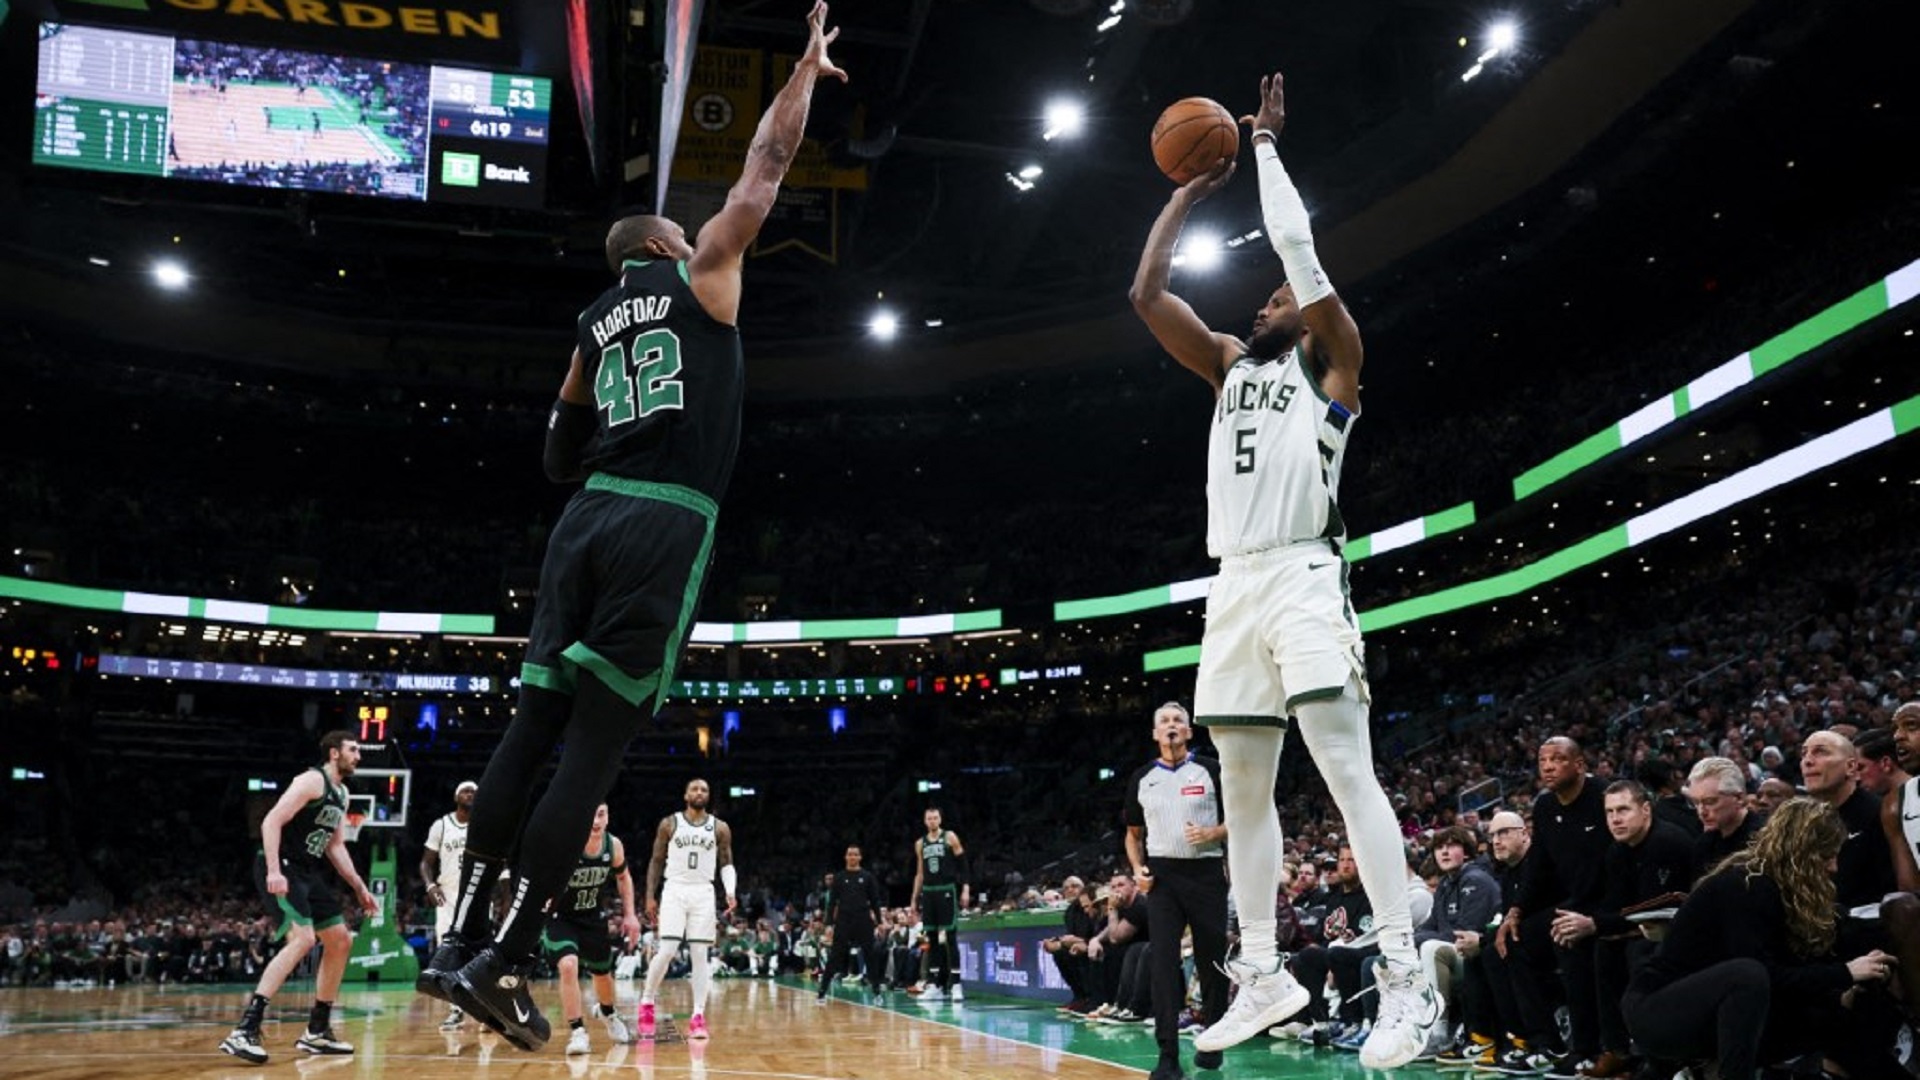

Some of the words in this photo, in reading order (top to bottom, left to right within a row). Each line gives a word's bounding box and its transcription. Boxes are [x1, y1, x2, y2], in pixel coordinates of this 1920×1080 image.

[698, 51, 751, 69] STON
[693, 71, 751, 89] RUINS
[448, 82, 476, 103] 38
[508, 89, 535, 109] 53
[705, 101, 723, 123] B
[470, 120, 512, 138] 6:19
[485, 163, 530, 183] Bank
[591, 296, 672, 348] HORFORD
[594, 328, 684, 428] 42
[1235, 428, 1257, 475] 5
[397, 675, 457, 690] MILWAUKEE
[469, 677, 490, 691] 38
[361, 719, 385, 741] 17
[443, 836, 468, 854] BUC
[674, 834, 715, 851] BUCKS
[687, 852, 699, 870] 0
[573, 887, 599, 911] 11
